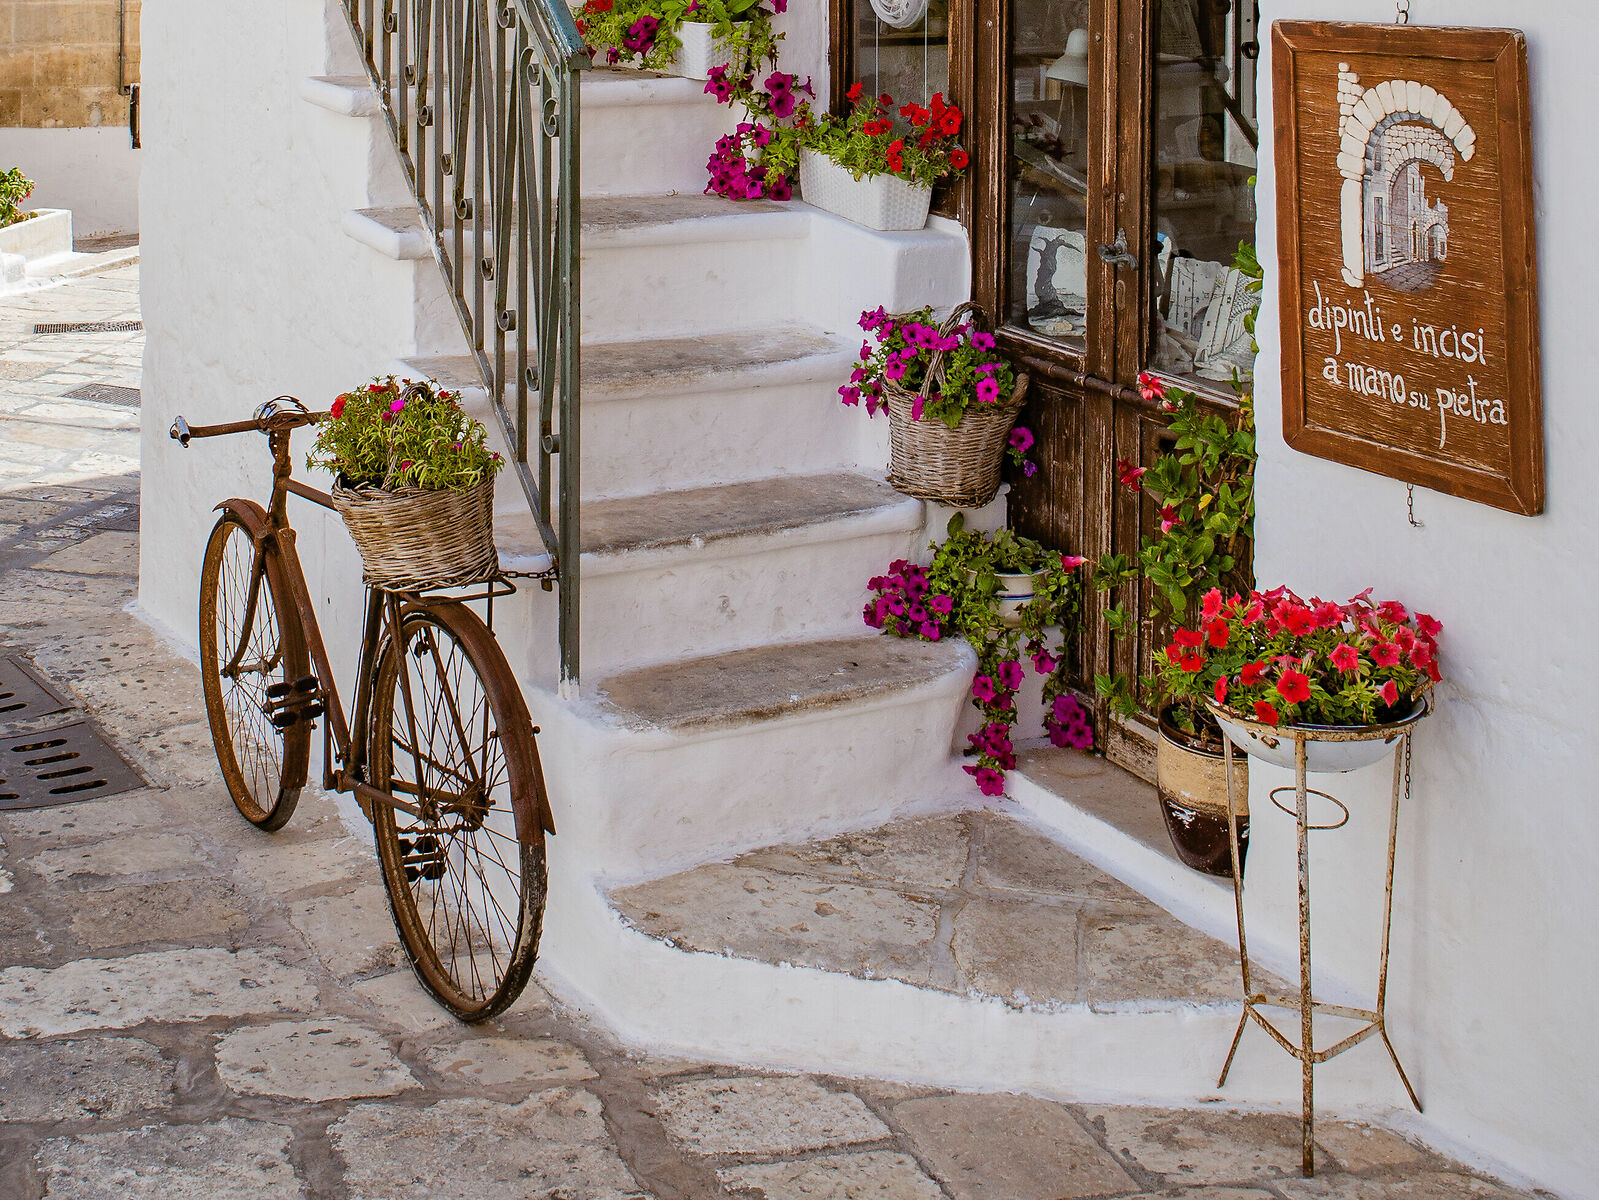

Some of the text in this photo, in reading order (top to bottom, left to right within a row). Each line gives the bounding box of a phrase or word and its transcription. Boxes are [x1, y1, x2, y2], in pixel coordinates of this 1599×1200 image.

[1308, 280, 1486, 365] dipinti e incisi
[1322, 357, 1508, 449] a mano su pietra
